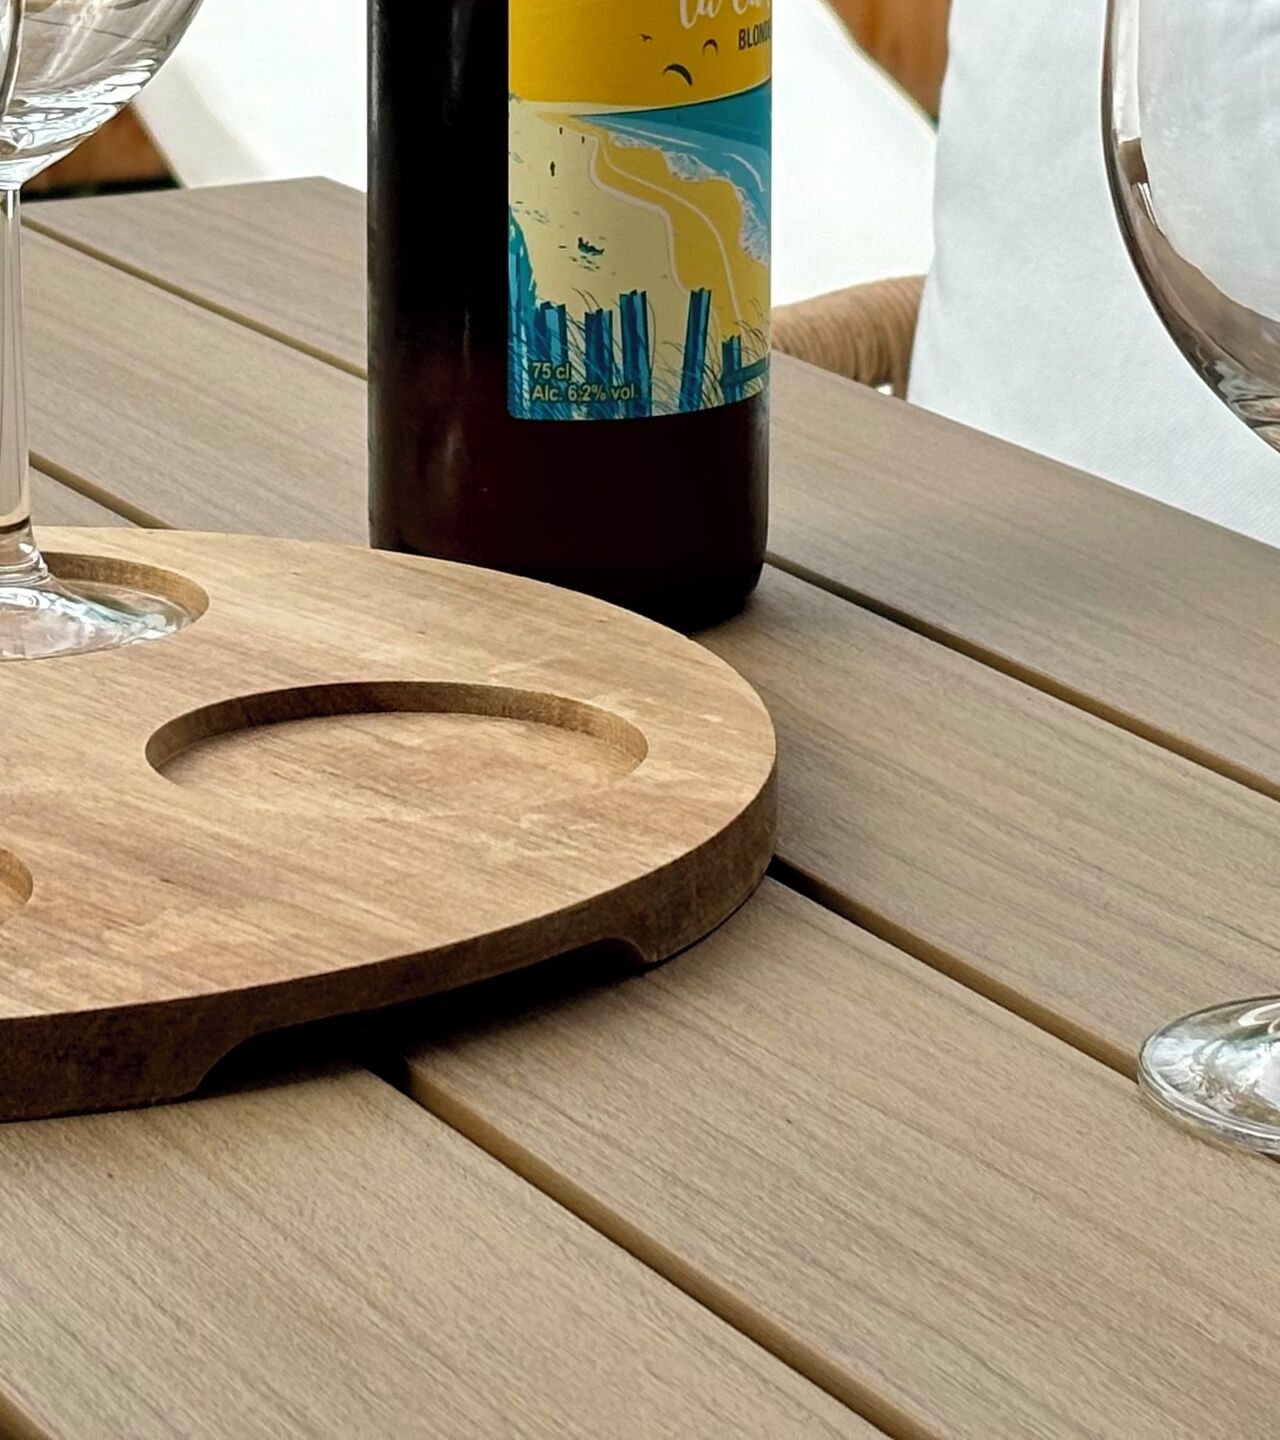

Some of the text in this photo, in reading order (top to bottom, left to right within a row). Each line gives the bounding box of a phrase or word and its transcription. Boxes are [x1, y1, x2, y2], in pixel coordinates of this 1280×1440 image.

[532, 362, 571, 379] 75 cl
[532, 385, 563, 401] Alc.
